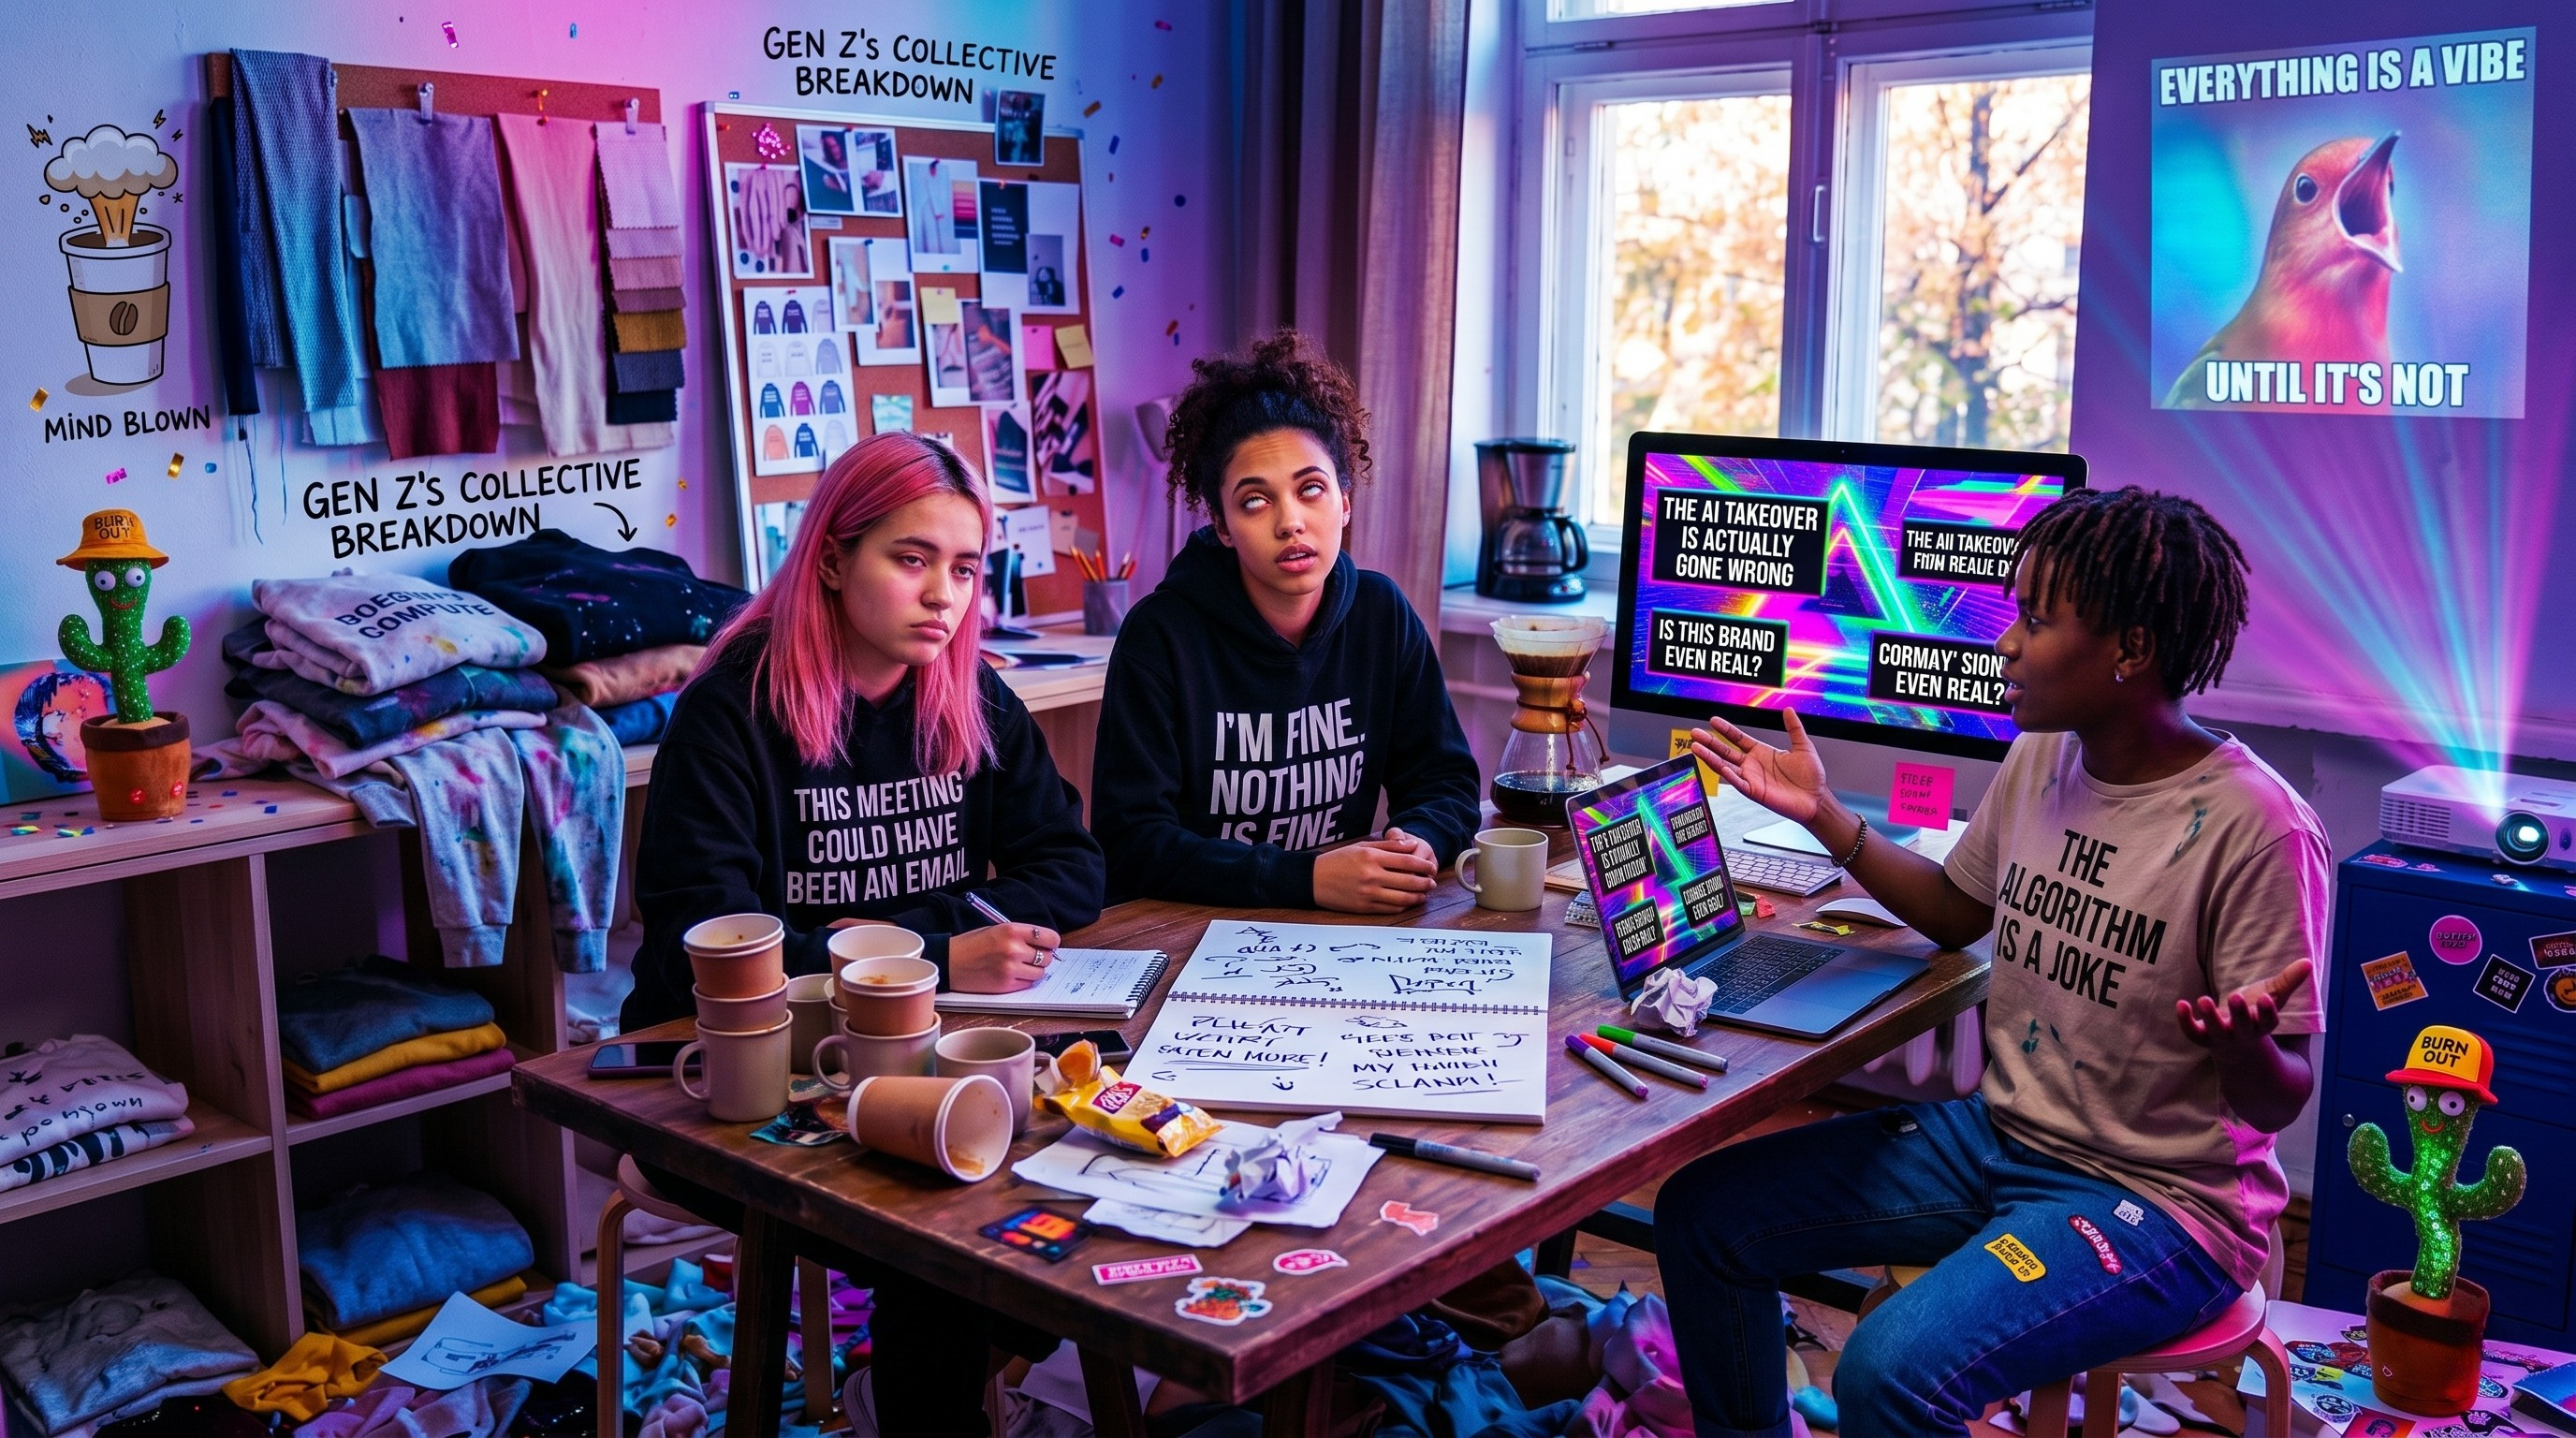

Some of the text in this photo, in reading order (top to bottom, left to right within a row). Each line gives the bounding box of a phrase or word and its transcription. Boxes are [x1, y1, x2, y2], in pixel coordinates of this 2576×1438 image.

[763, 26, 825, 60] GEN
[893, 35, 1057, 81] COLLECTIVE
[2159, 38, 2526, 106] EVERYTHING IS A VIBE
[796, 66, 973, 104] BREAKDOWN
[2204, 360, 2470, 408] UNTIL IT'S NOT
[124, 404, 211, 436] BLOWN
[302, 477, 379, 520] GEN
[460, 458, 642, 504] COLLECTIVE
[98, 527, 130, 540] OUT
[330, 502, 541, 559] BREAKDOWN
[1663, 496, 1819, 532] THE AI TAKEOVER
[1681, 525, 1795, 558] IS ACTUALLY
[1906, 529, 1934, 550] THE
[1676, 553, 1794, 587] GONE WRONG
[359, 603, 496, 639] COMPUTE
[1659, 618, 1776, 653] IS THIS BRAND
[1664, 645, 1763, 678] EVEN REAL?
[1895, 670, 2005, 706] EVEN REAL?
[1215, 697, 1366, 762] I'M FINE.
[793, 770, 964, 822] THIS MEETING
[1209, 750, 1365, 815] NOTHING
[808, 812, 959, 864] COULD HAVE
[1266, 803, 1345, 852] FINE.
[786, 846, 970, 904] BEEN AN EMAIL
[2057, 829, 2118, 888] THE
[1998, 861, 2167, 965] ALGORITHM
[1996, 915, 2127, 1009] IS A JOKE
[2421, 1035, 2469, 1057] BURN
[2422, 1049, 2461, 1068] OUT
